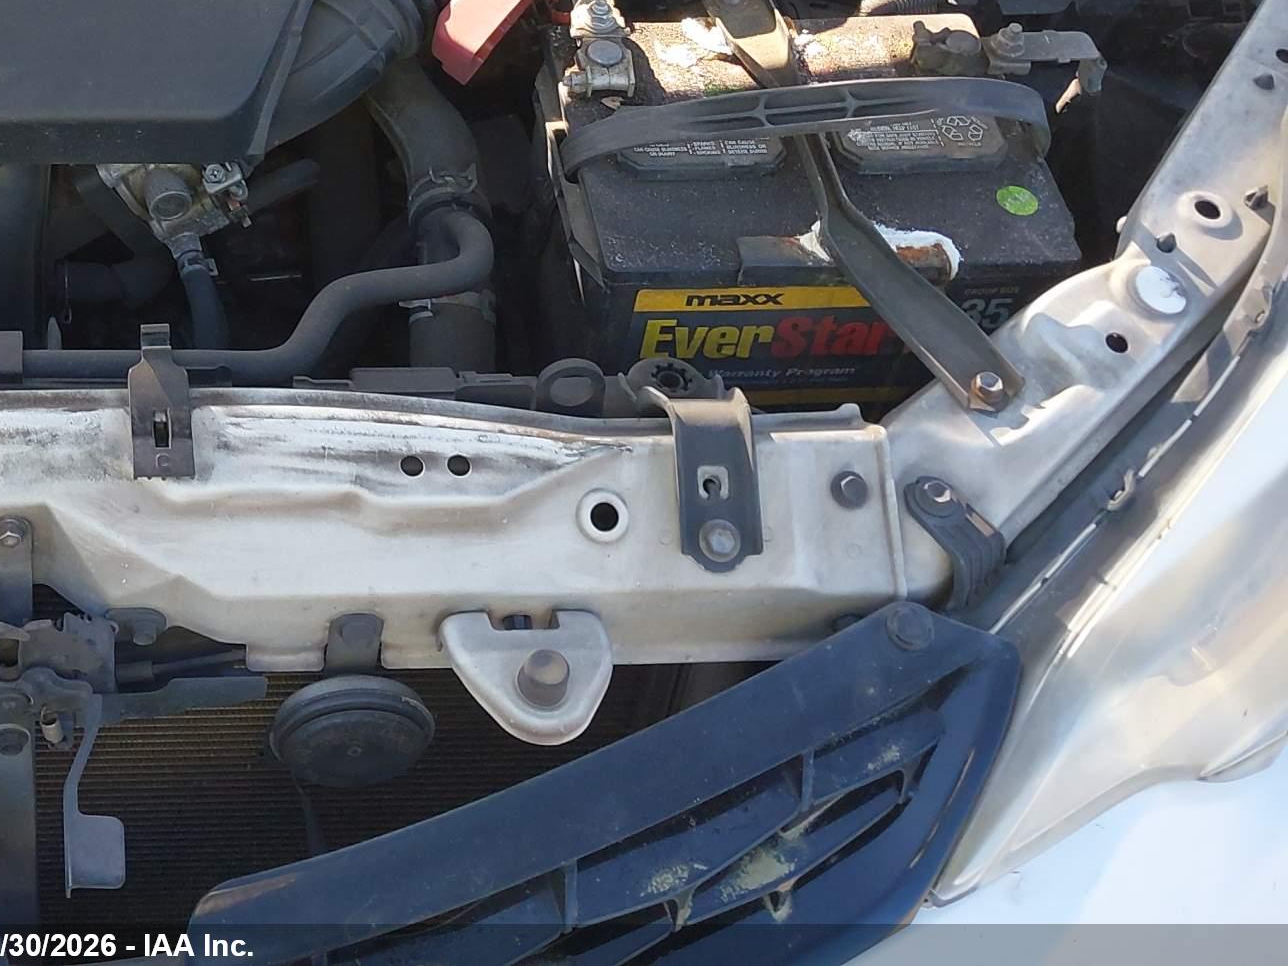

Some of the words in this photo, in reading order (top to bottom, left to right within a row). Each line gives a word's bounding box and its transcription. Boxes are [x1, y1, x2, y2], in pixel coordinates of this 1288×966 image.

[685, 293, 785, 307] maxx
[961, 298, 1013, 330] 35
[639, 316, 898, 359] EverStar
[785, 367, 856, 378] Program
